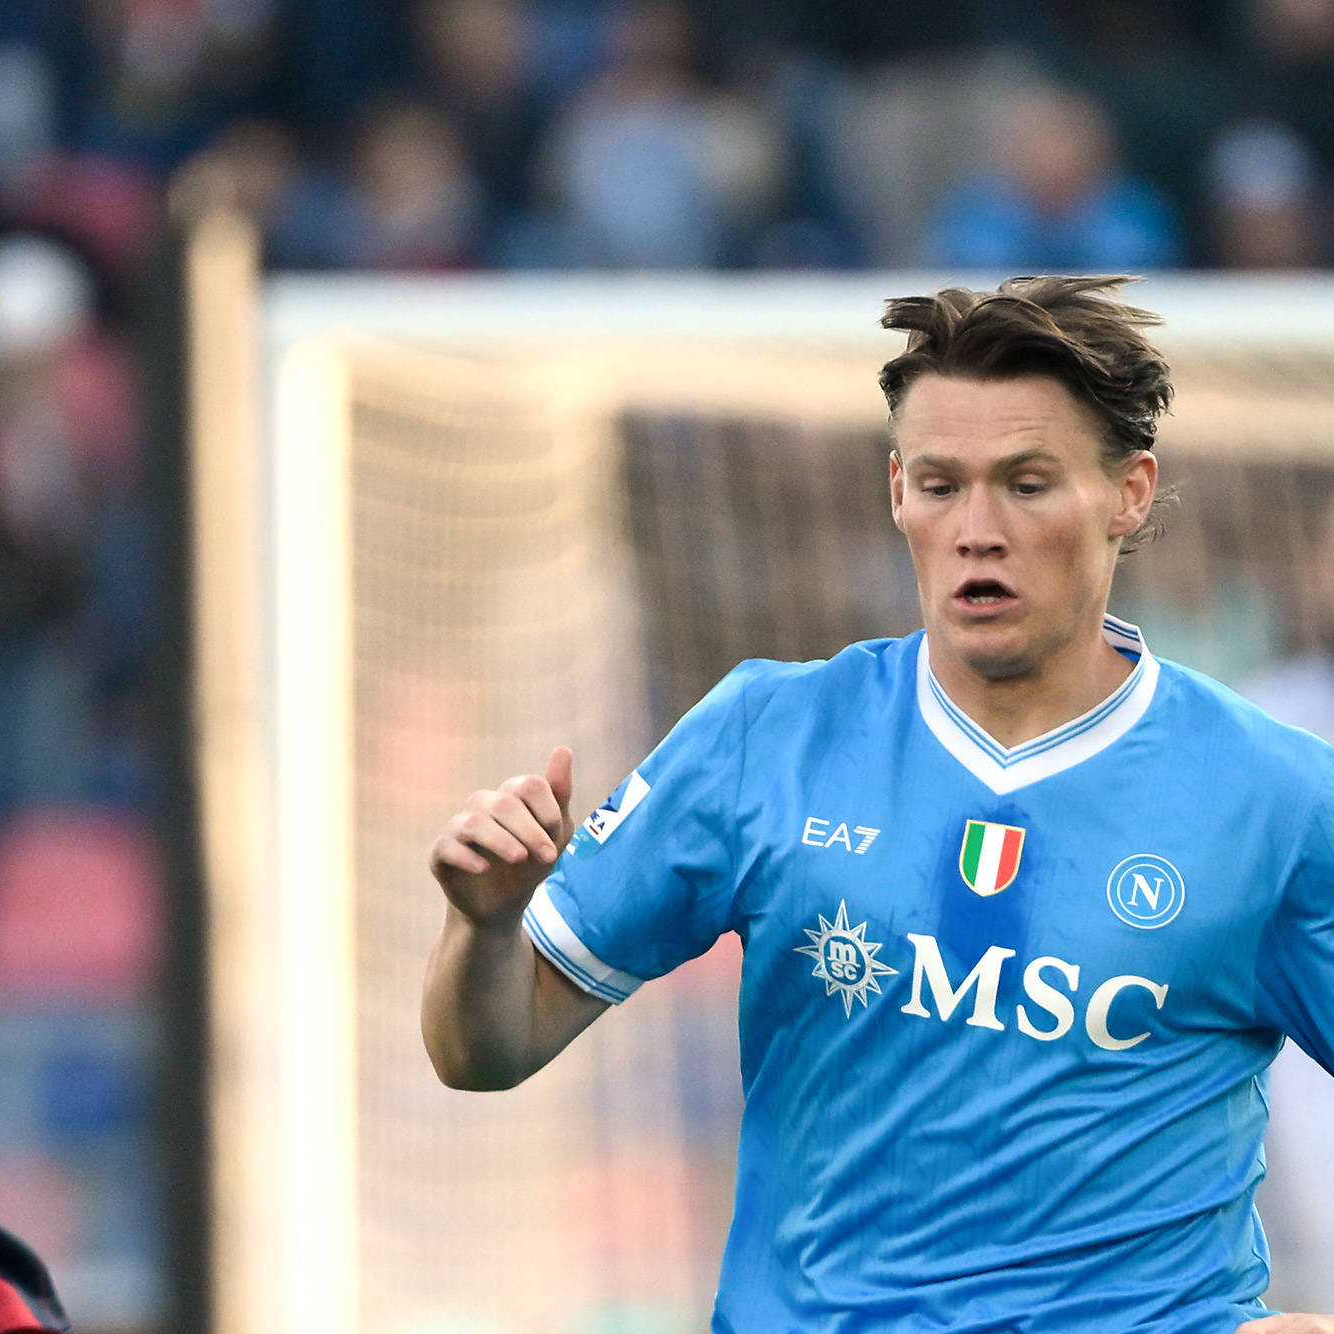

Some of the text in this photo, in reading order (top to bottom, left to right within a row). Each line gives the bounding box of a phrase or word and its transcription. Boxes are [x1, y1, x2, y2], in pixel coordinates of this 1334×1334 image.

[802, 816, 881, 855] EA7
[1127, 873, 1165, 911] N
[900, 932, 1169, 1051] MSC
